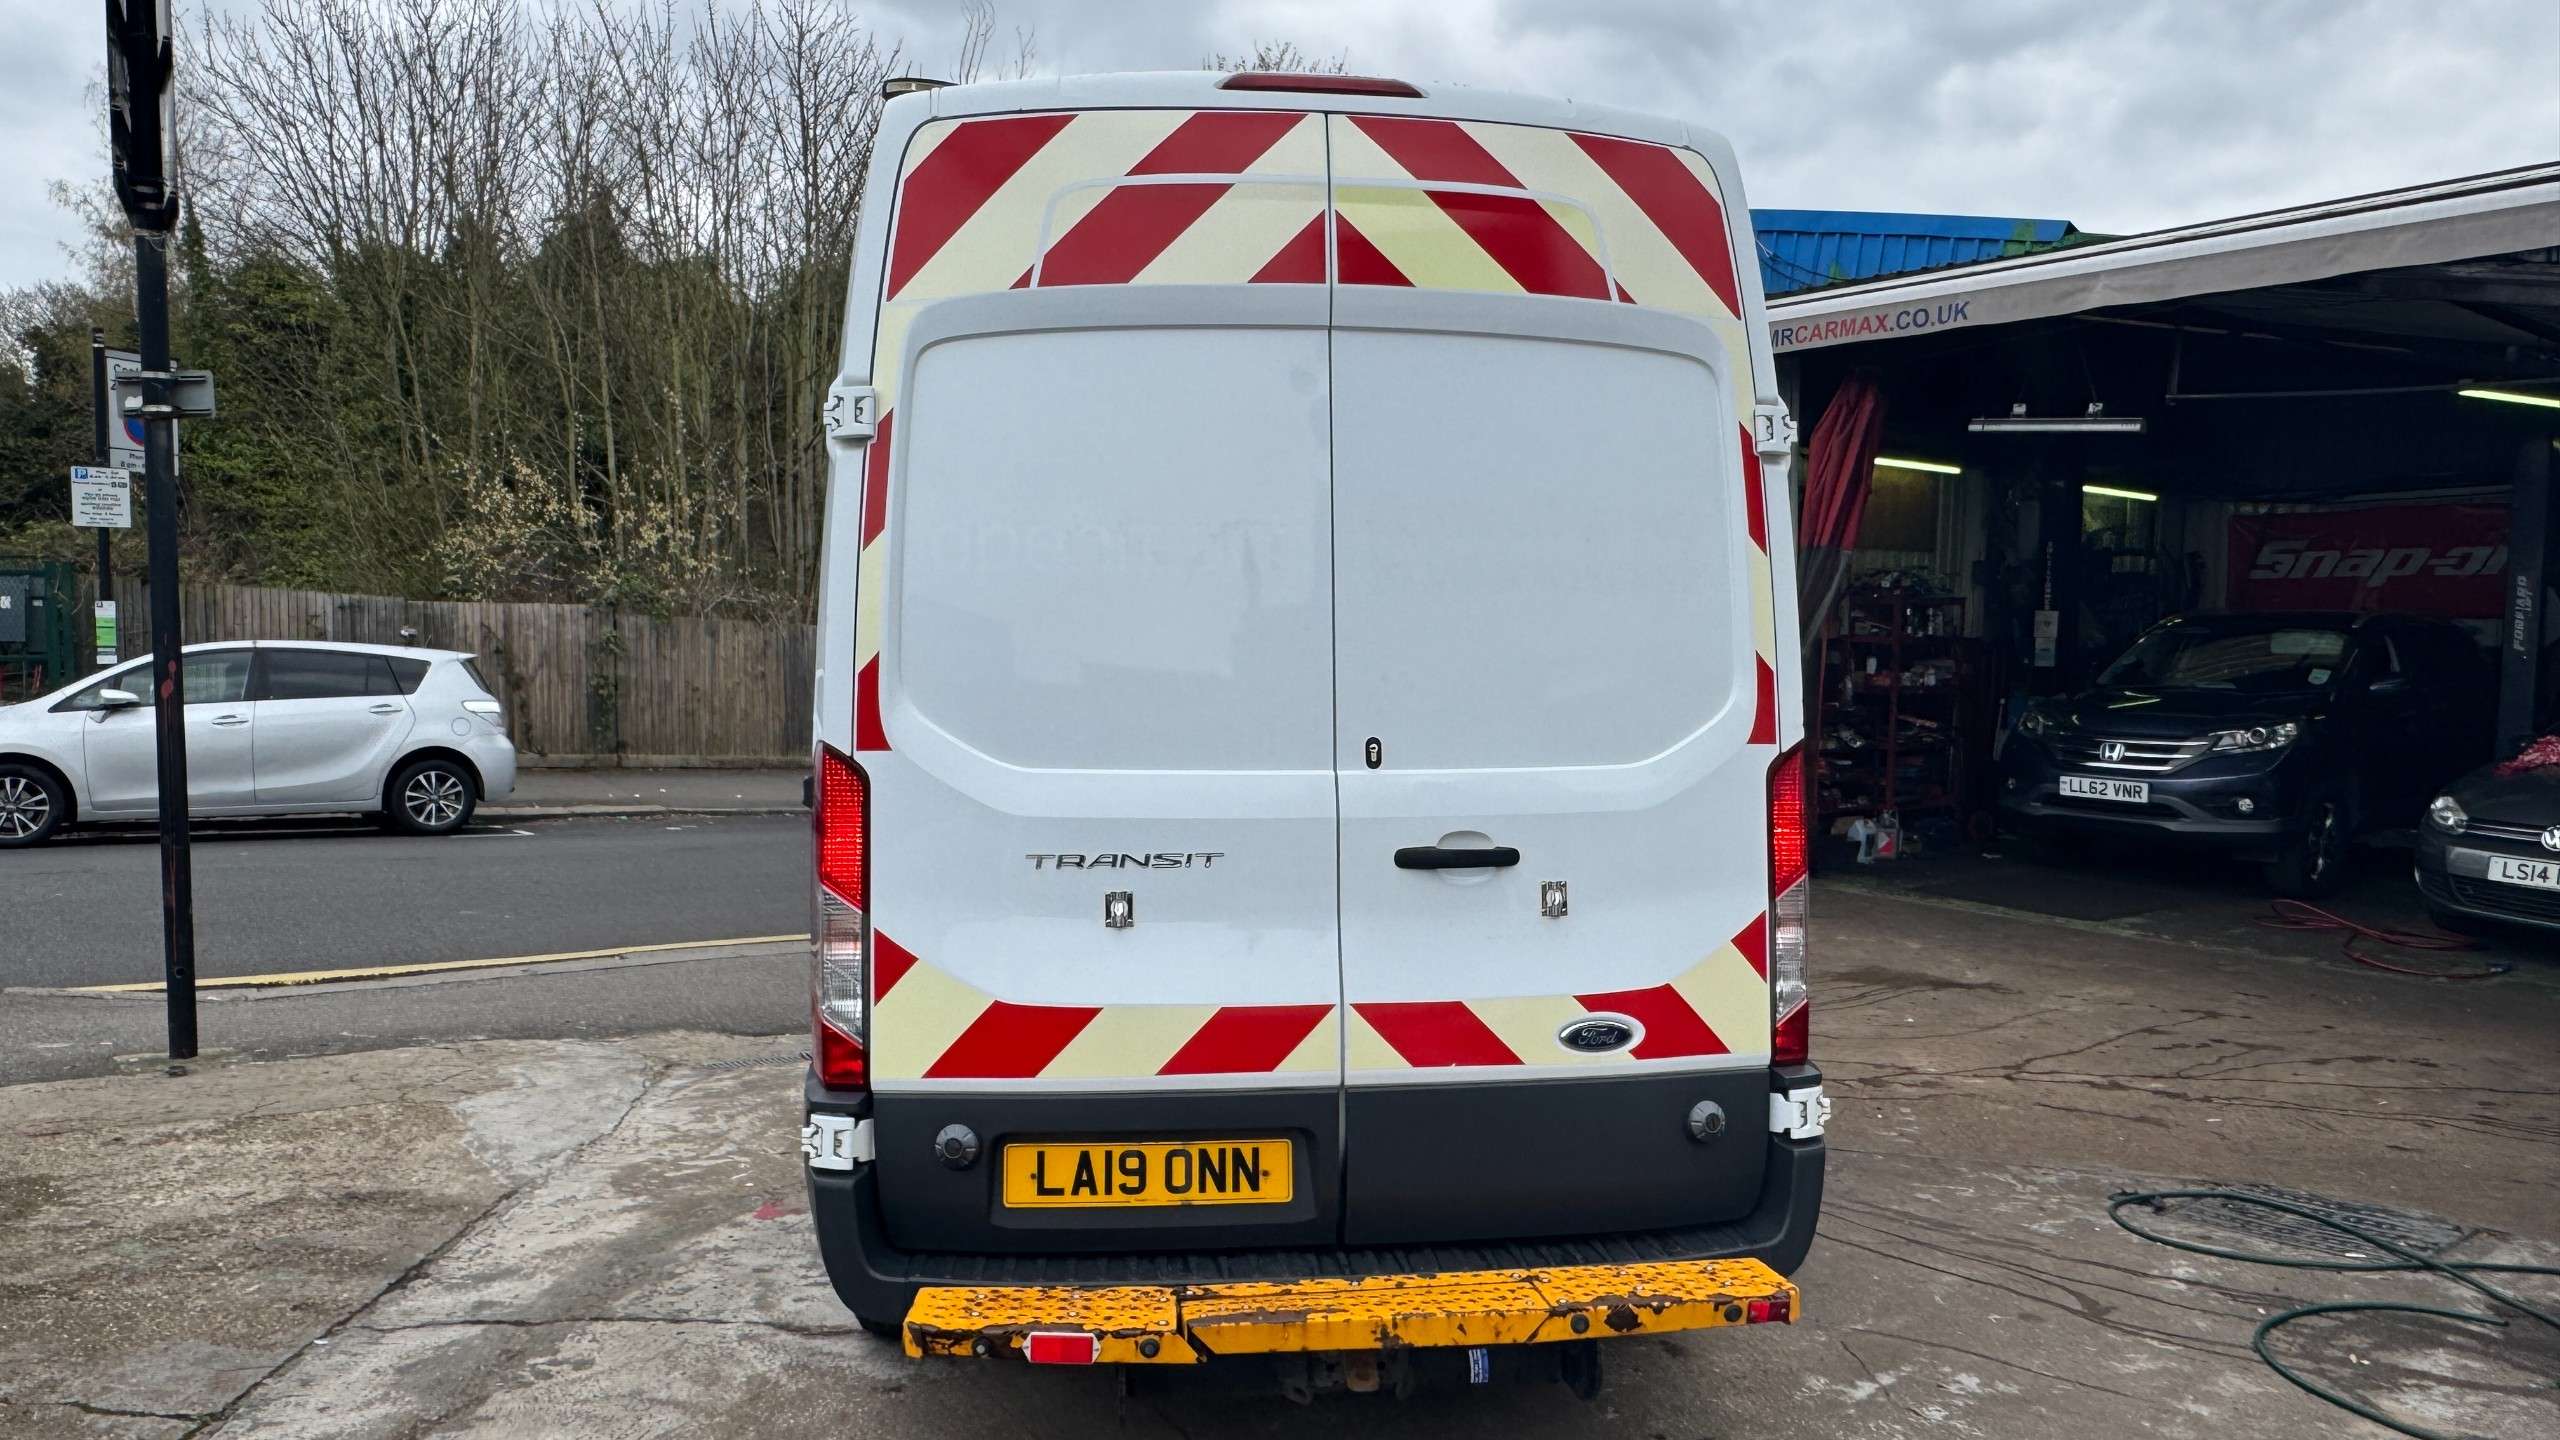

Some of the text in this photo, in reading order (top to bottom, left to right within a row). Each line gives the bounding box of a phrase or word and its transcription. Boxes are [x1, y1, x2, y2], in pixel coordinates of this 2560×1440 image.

[2069, 778, 2108, 796] LL62
[2113, 783, 2143, 800] VNR
[1024, 852, 1225, 870] TRANSIT
[2502, 861, 2550, 884] LS14
[1578, 1027, 1618, 1045] Ford
[1036, 1147, 1260, 1196] LA19 ONN
